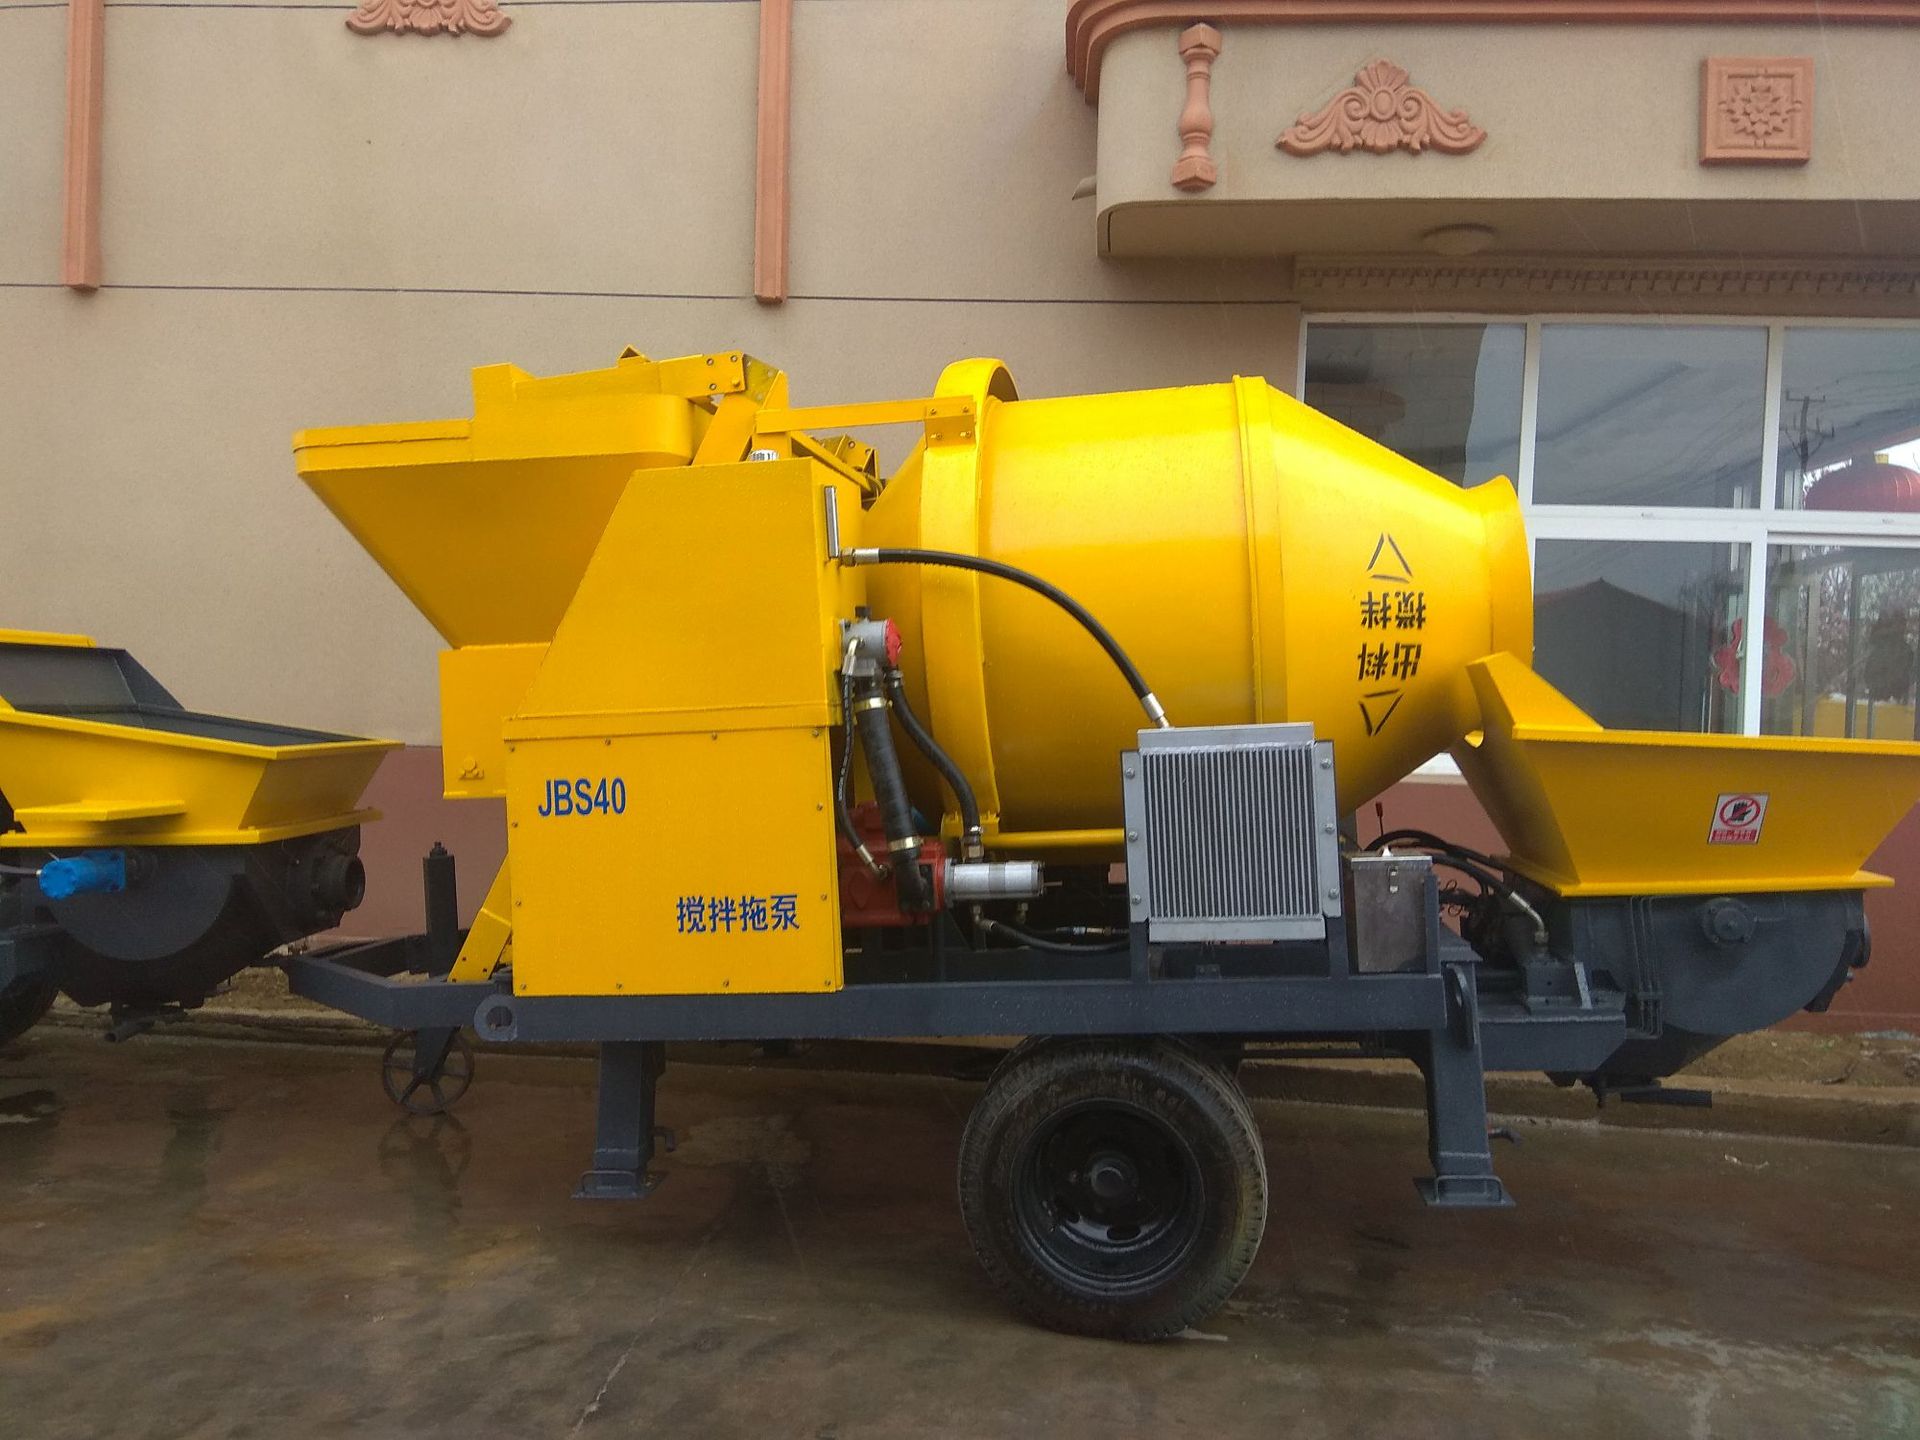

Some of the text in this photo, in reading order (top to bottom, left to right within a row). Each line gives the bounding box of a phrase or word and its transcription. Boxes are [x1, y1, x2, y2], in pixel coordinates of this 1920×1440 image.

[1360, 591, 1427, 629] 搅拌
[1357, 642, 1422, 681] 出料
[538, 777, 626, 817] JBS40
[676, 894, 800, 934] 搅拌拖泵
